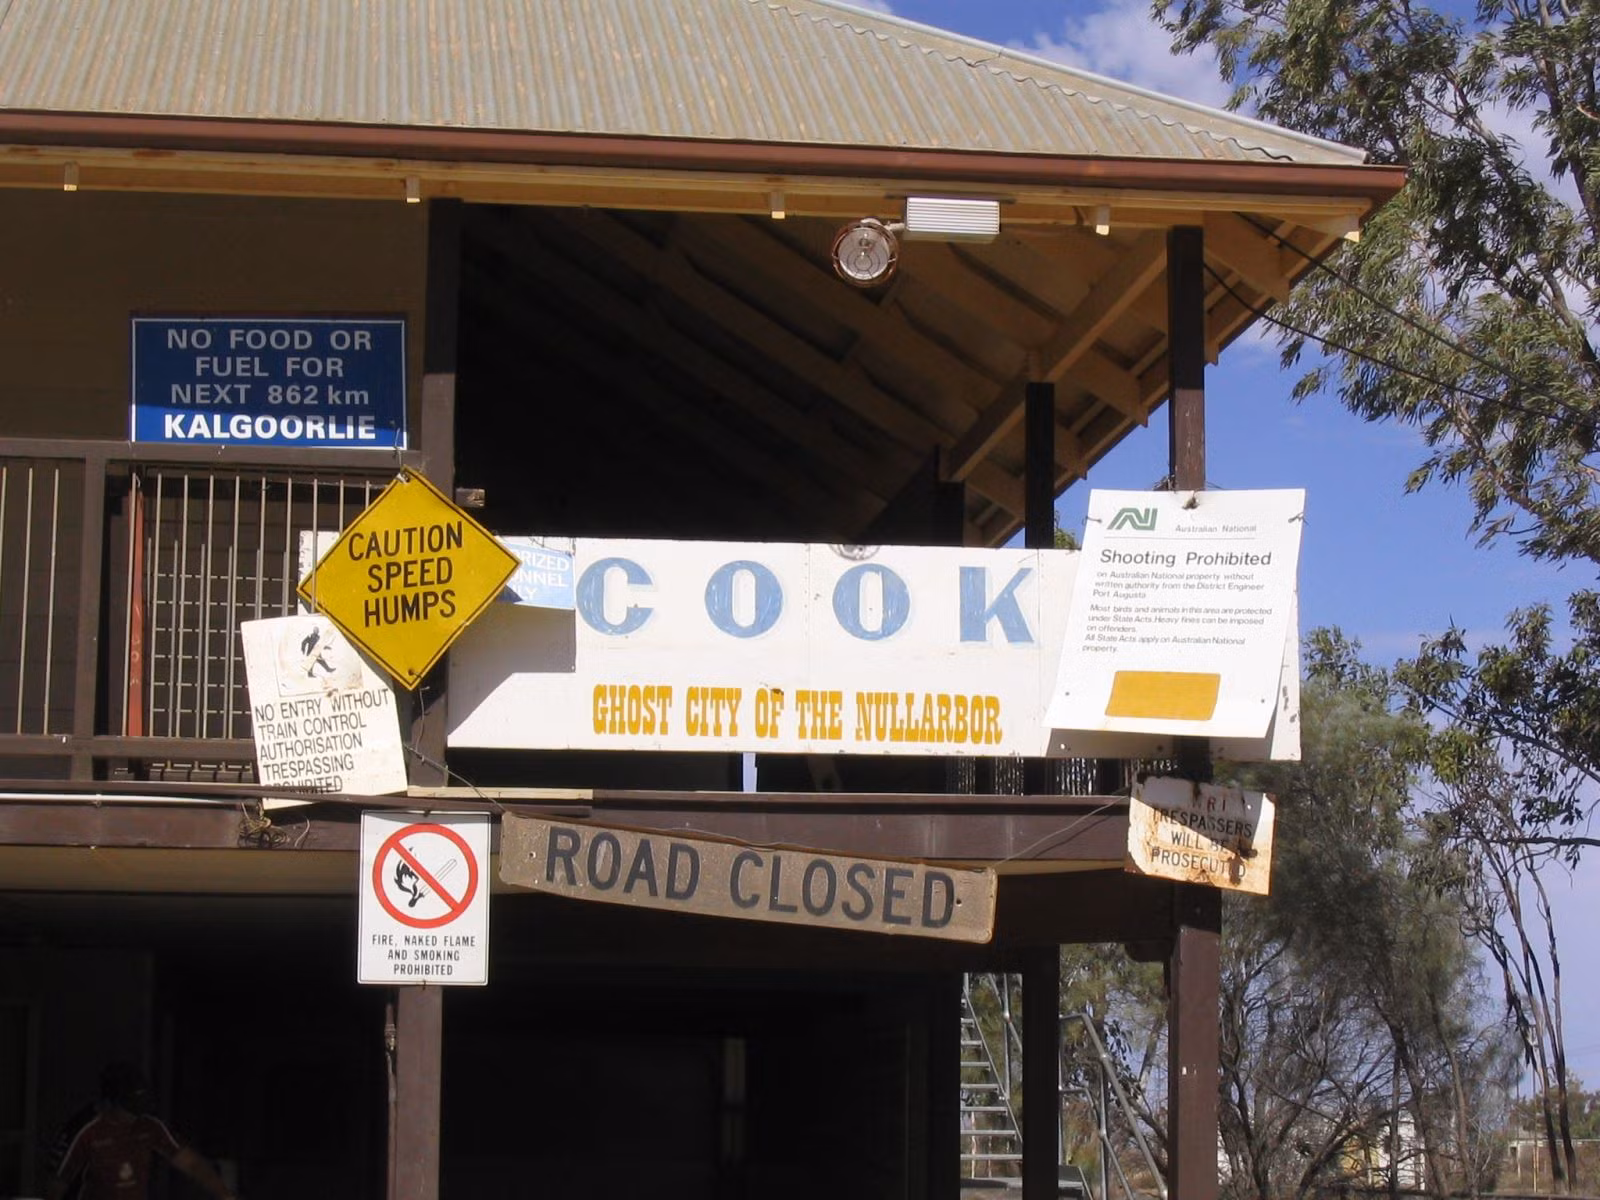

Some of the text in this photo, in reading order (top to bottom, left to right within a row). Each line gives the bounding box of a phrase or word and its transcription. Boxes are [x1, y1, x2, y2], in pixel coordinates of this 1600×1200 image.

[167, 328, 372, 351] NO FOOD OR
[195, 356, 344, 378] FUEL FOR
[171, 384, 369, 405] NEXT 862 km
[164, 414, 376, 440] KALGOORLIE
[1175, 524, 1257, 533] Australian National
[348, 520, 463, 562] CAUTION
[1099, 549, 1272, 568] Shooting Prohibited
[367, 556, 453, 593] SPEED
[1109, 571, 1150, 579] Australian
[1151, 571, 1185, 580] National
[1185, 573, 1220, 581] property
[1092, 588, 1146, 599] Port Augusta
[1095, 581, 1123, 589] written
[1124, 582, 1159, 590] authority
[1196, 582, 1226, 590] District
[1227, 583, 1264, 592] Engineer
[363, 590, 456, 628] HUMPS
[576, 557, 1035, 643] COOK
[1089, 604, 1110, 612] Most
[1188, 606, 1202, 614] this
[1112, 614, 1133, 622] State
[1154, 616, 1180, 624] Heavy
[1217, 616, 1228, 624] be
[1229, 617, 1265, 625] imposed
[1084, 633, 1095, 641] All
[1097, 633, 1118, 642] State
[1137, 635, 1159, 644] apply
[1171, 635, 1211, 644] Australian
[1211, 636, 1246, 645] National
[254, 688, 390, 722] NO ENTRY WITHOUT
[592, 684, 1003, 745] GHOST CITY OF THE NULLARBOR
[258, 712, 367, 742] TRAIN CONTROL
[260, 733, 363, 761] AUTHORISATION
[263, 753, 354, 781] TRESPASSING
[1152, 807, 1252, 837] TRESPASSERS
[1170, 830, 1204, 850] WILL
[1151, 846, 1247, 878] PROSECUTD
[545, 825, 955, 928] ROAD CLOSED
[372, 934, 476, 947] FIRE, NAKED FLAME
[387, 949, 460, 962] AND SMOKING
[393, 963, 453, 976] PROHIBITED
